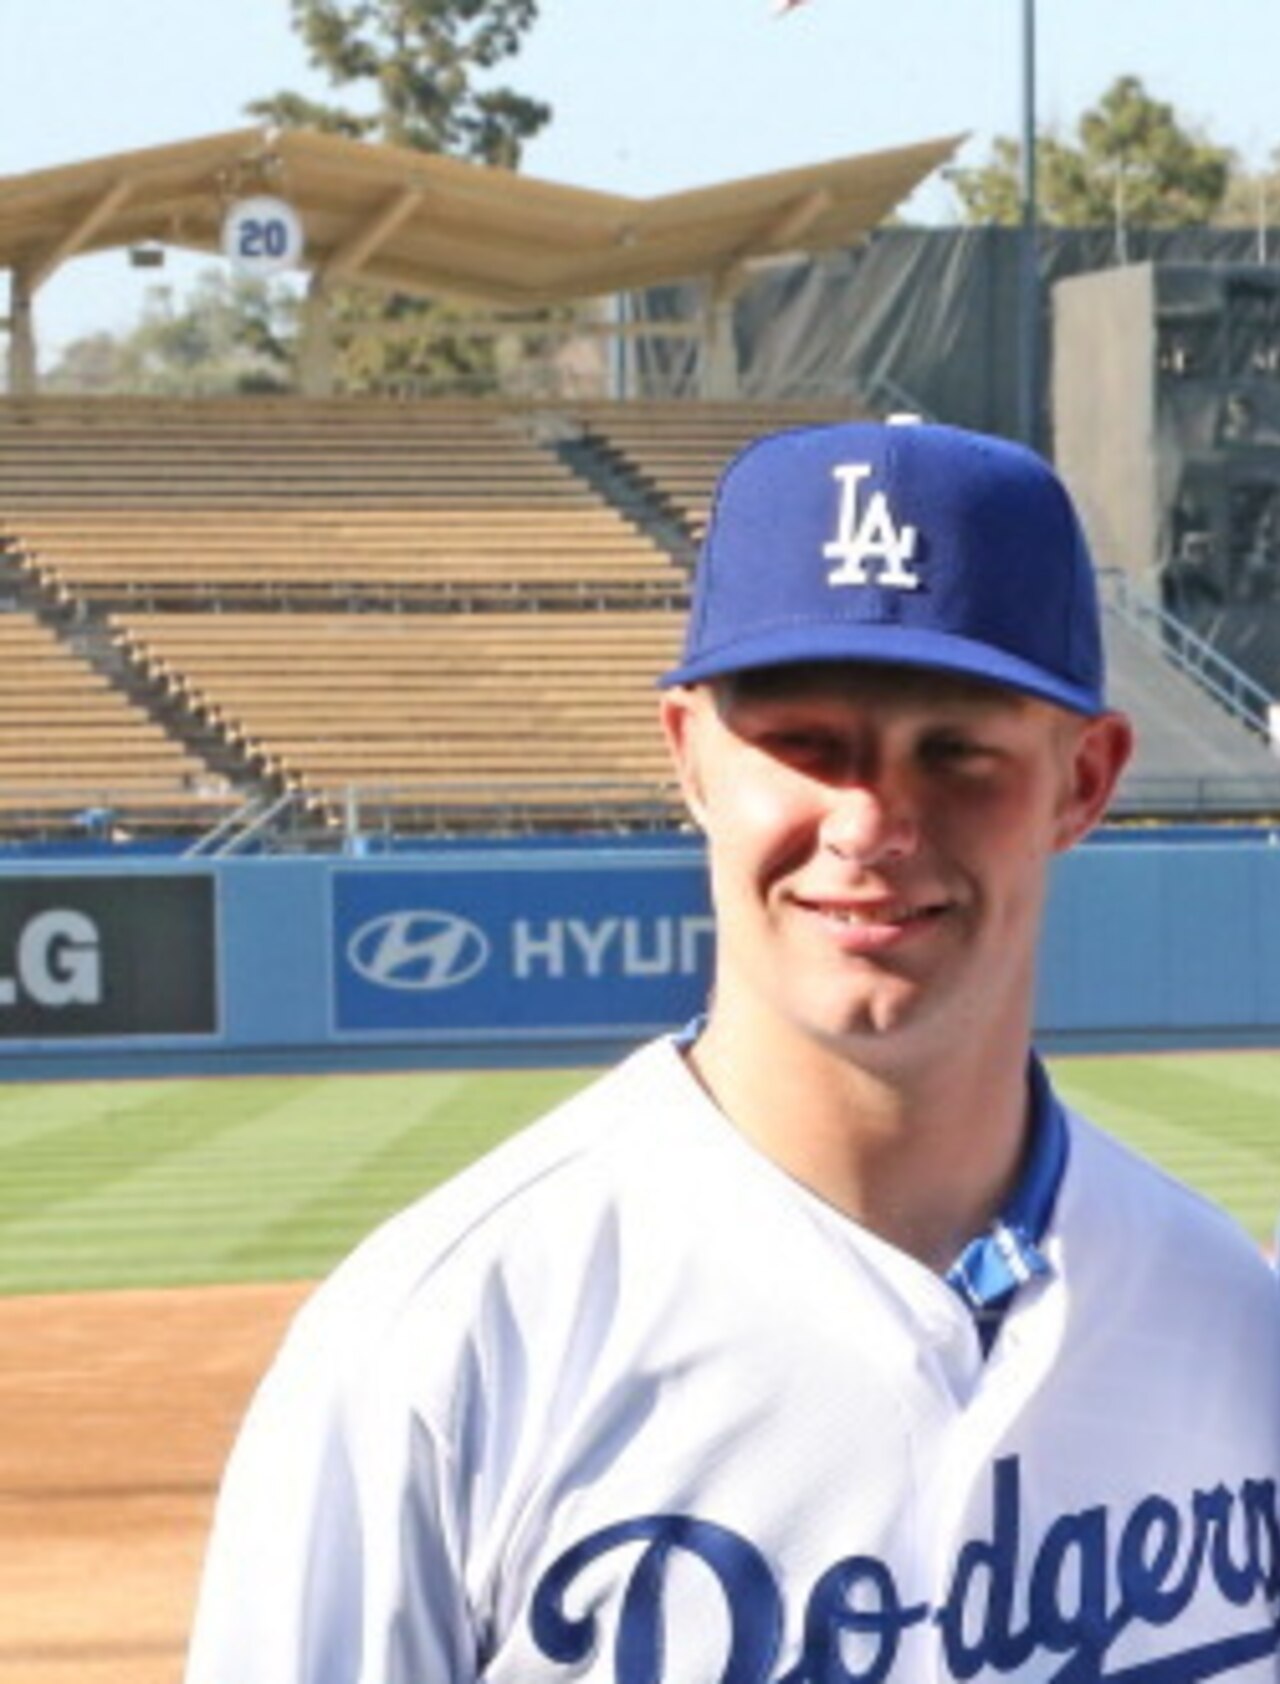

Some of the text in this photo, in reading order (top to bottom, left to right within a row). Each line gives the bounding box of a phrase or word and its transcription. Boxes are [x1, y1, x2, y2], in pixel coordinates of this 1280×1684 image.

[239, 217, 288, 257] 20
[822, 464, 920, 589] LA
[0, 909, 100, 1006] G
